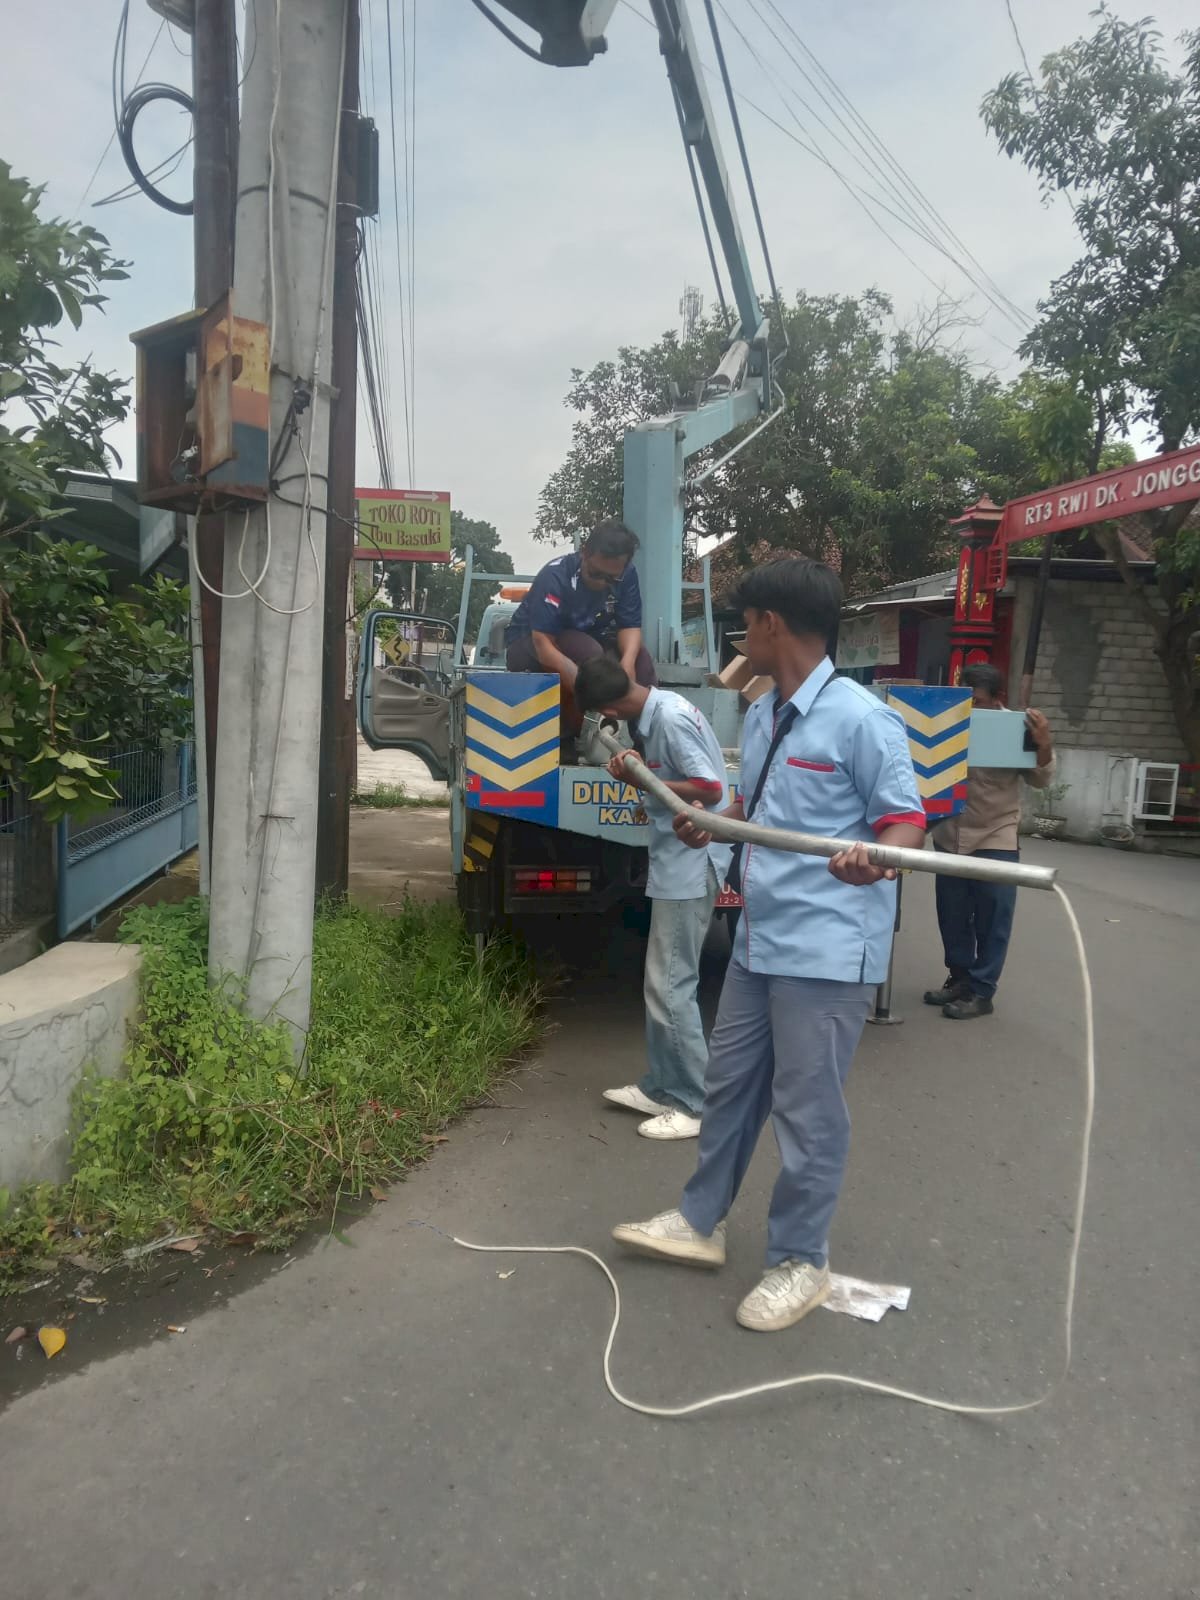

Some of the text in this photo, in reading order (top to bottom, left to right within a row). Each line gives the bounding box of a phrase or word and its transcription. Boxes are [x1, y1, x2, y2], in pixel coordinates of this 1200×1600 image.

[369, 504, 441, 526] TOKO ROTI
[1025, 502, 1052, 526] RT3
[370, 525, 441, 546] Ibu Basuki
[573, 781, 645, 804] DINA
